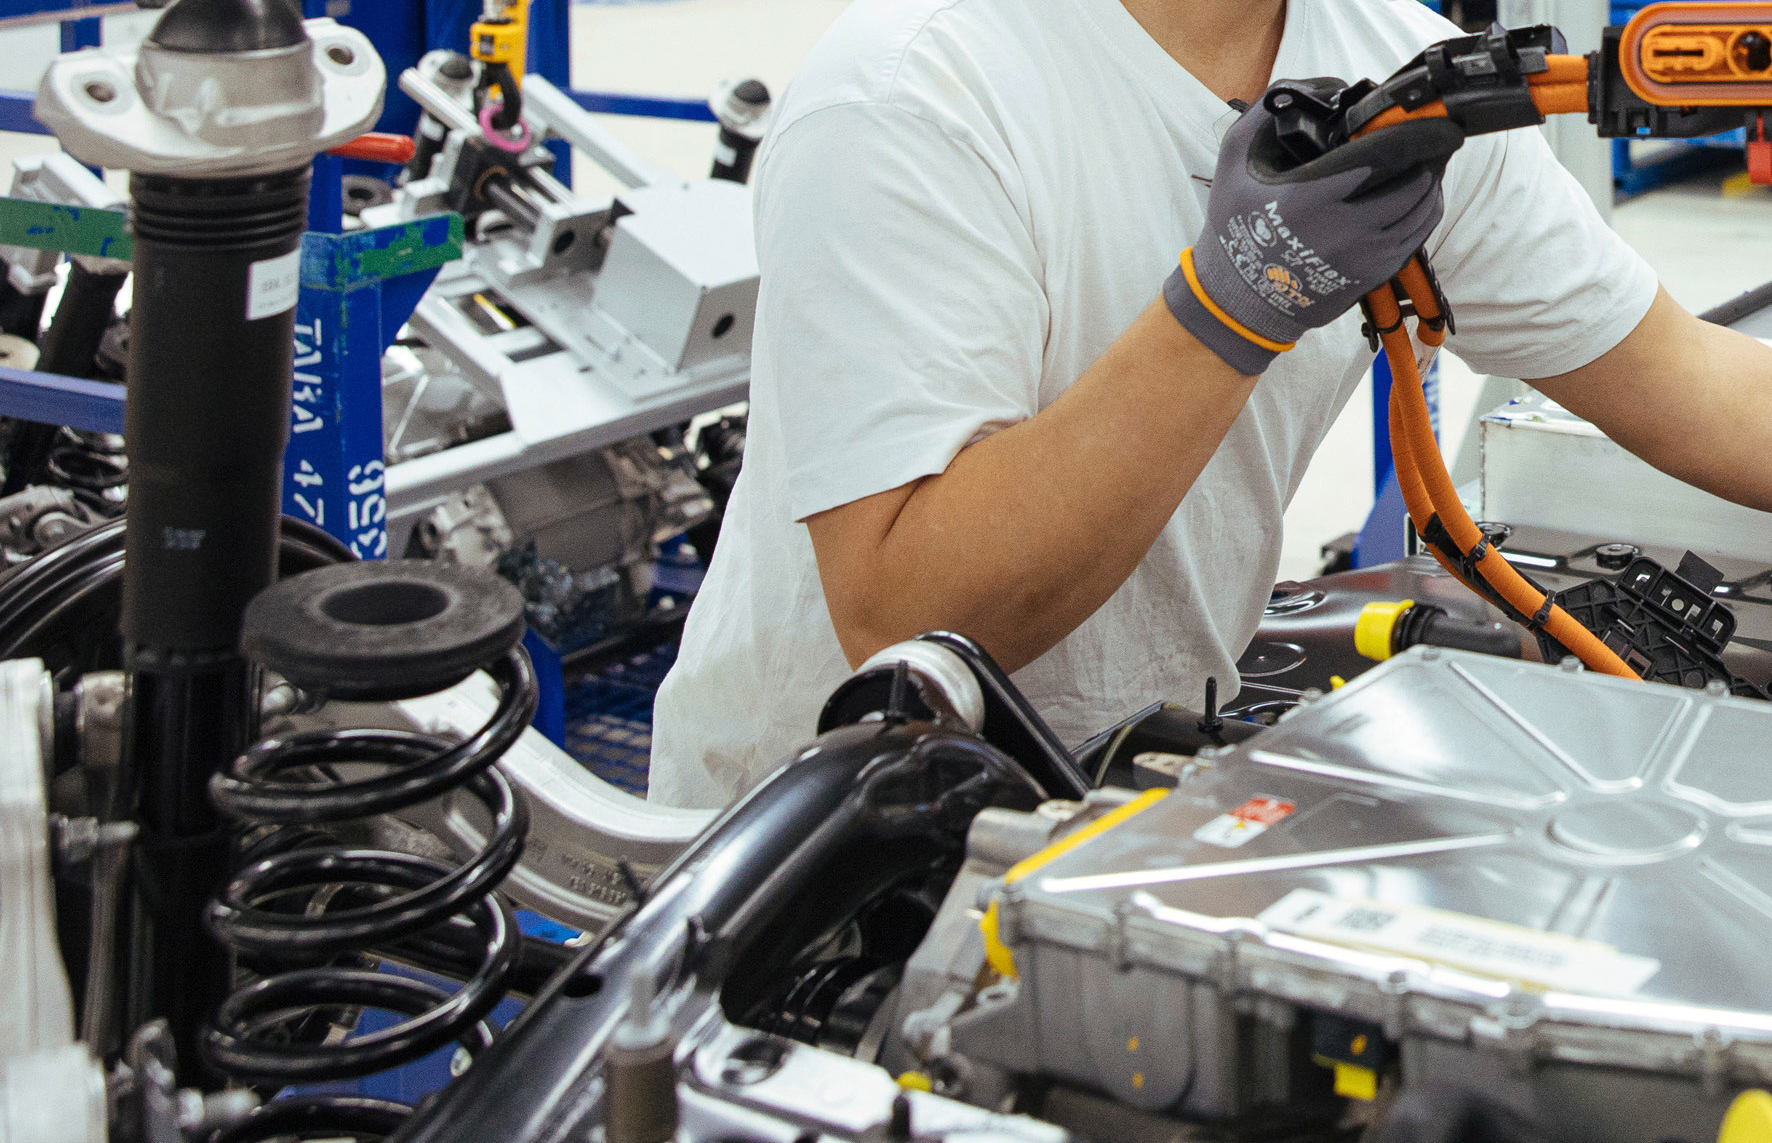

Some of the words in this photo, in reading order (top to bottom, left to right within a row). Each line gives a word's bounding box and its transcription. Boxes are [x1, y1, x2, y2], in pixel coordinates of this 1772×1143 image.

[1265, 201, 1351, 282] MaxiFlex
[293, 318, 323, 434] TARA
[293, 459, 324, 526] 47
